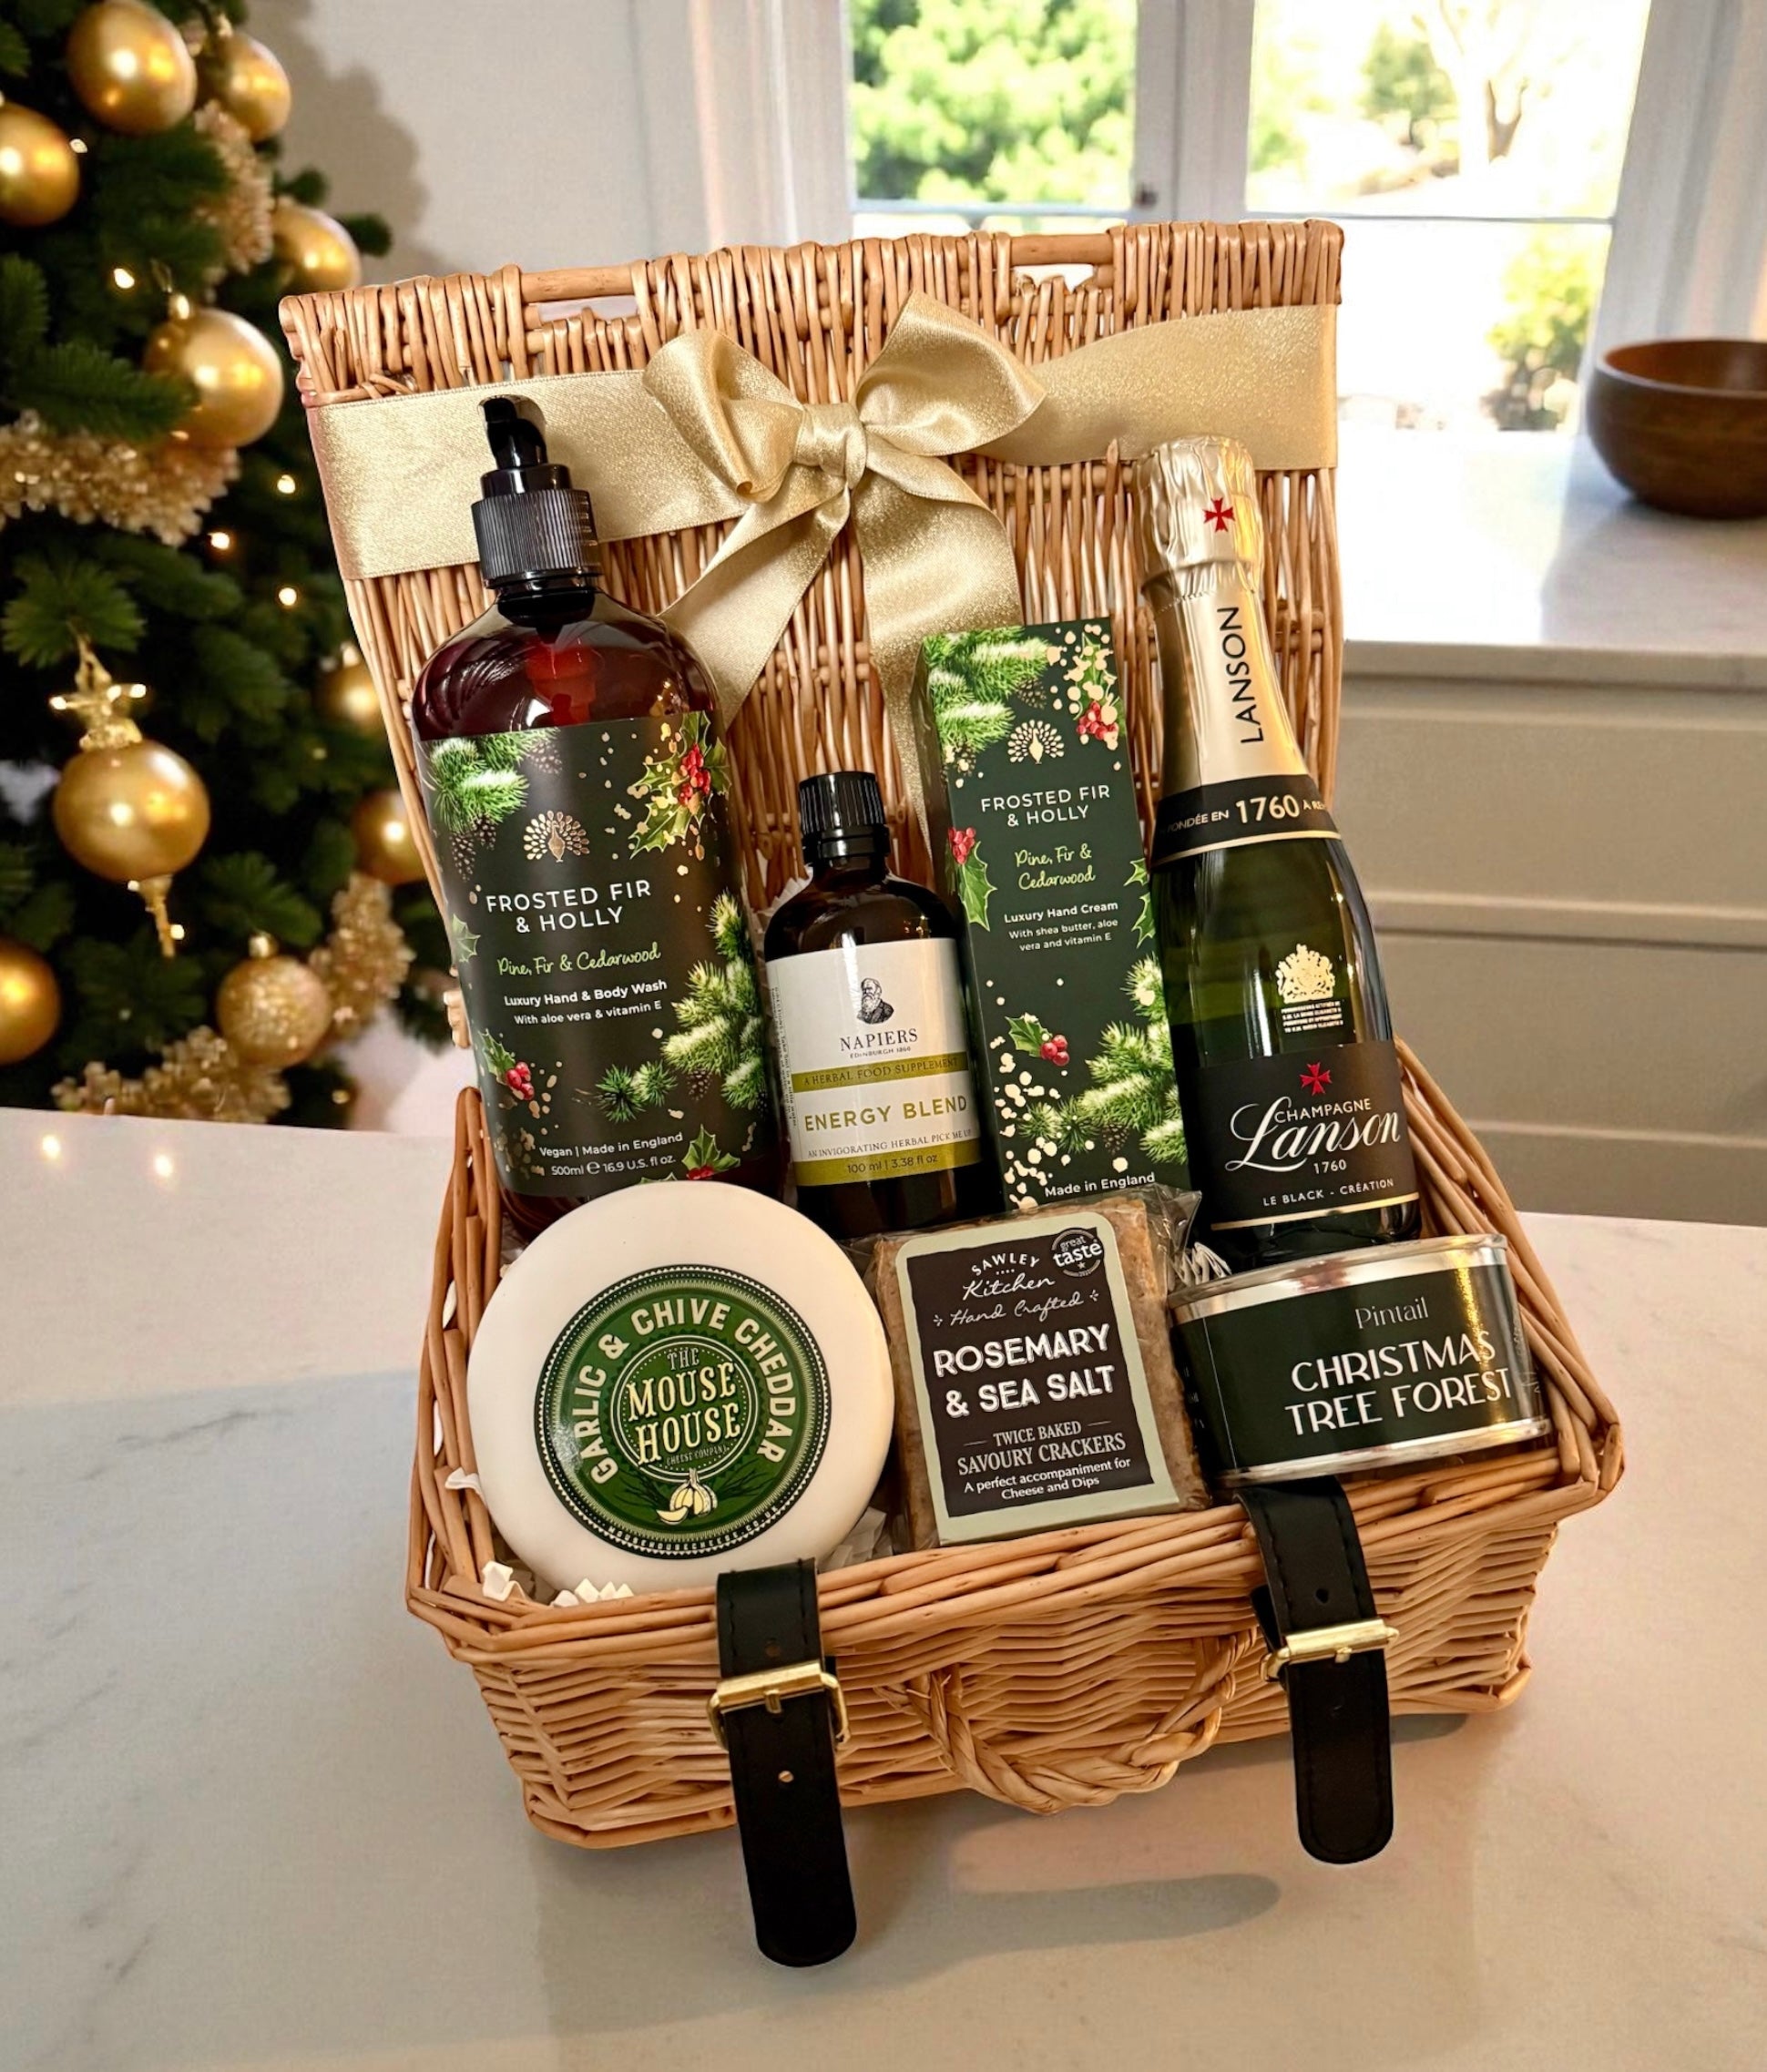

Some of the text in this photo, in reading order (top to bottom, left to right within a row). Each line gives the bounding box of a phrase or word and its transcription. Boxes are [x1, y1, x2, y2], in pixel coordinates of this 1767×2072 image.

[1217, 607, 1264, 743] LANSON
[981, 784, 1109, 812] FROSTED FIR
[1211, 810, 1230, 822] EN
[1236, 794, 1300, 823] 1760
[1007, 804, 1088, 827] & HOLLY
[1015, 843, 1092, 867] Pine, Fir &
[1018, 865, 1096, 890] Cedarwood
[486, 880, 651, 913] FROSTED FIR
[516, 906, 622, 933] & HOLLY
[1004, 902, 1118, 924] Luxury Hand Cream
[1008, 918, 1118, 940] With shea butter, aloe
[1019, 933, 1111, 952] vera and vitamin E
[497, 942, 661, 975] Pine, Fir & Cedarwood
[505, 980, 668, 1007] Luxury Hand & Body Wash
[514, 1001, 662, 1025] With aloe vera & vitamin E
[840, 1028, 918, 1051] NAPIERS
[850, 1048, 894, 1058] EDINBURGH
[812, 1071, 853, 1085] HERBAL
[858, 1067, 891, 1078] FOOD
[895, 1057, 958, 1075] SUPPLEMENT
[805, 1096, 967, 1131] ENERGY BLEND
[1275, 1098, 1372, 1123] CHAMPAGNE
[539, 1147, 573, 1158] Vegan
[582, 1144, 615, 1155] Made
[618, 1142, 629, 1152] in
[633, 1132, 683, 1150] England
[808, 1149, 817, 1158] AN
[820, 1142, 888, 1157] INVIGORATING
[892, 1137, 928, 1148] HERBAL
[932, 1132, 950, 1142] PICK
[953, 1130, 963, 1139] ME
[1225, 1097, 1400, 1172] Lanson
[551, 1165, 584, 1176] 500ml
[603, 1161, 625, 1173] 16.9
[627, 1158, 649, 1169] U.S.
[660, 1155, 676, 1164] oz.
[847, 1163, 865, 1173] 100
[869, 1161, 882, 1171] ml
[892, 1158, 914, 1169] 3.38
[917, 1156, 924, 1164] fl
[927, 1155, 938, 1163] oz
[1313, 1159, 1347, 1174] 1760
[1045, 1172, 1155, 1197] Made in England
[1263, 1196, 1276, 1207] LE
[1282, 1189, 1323, 1204] BLACK
[1340, 1179, 1394, 1194] CRÉATION
[1053, 1243, 1102, 1267] taste
[1060, 1236, 1086, 1252] great
[971, 1253, 1040, 1276] SAWLEY
[962, 1273, 1056, 1301] Kitchen
[950, 1292, 1084, 1327] Hand Crafted
[1354, 1297, 1429, 1330] Pintail
[668, 1347, 700, 1370] THE
[933, 1323, 1109, 1377] ROSEMARY
[1291, 1332, 1496, 1393] CHRISTMAS
[572, 1298, 796, 1485] GARLIC & CHIVE CHEDDAR
[627, 1362, 736, 1422] MOUSE
[945, 1365, 1115, 1418] & SEA SALT
[1284, 1368, 1512, 1435] TREE FOREST
[635, 1403, 741, 1465] HOUSE
[993, 1420, 1082, 1447] TWICE BAKED
[957, 1433, 1126, 1475] SAVOURY CRACKERS
[964, 1458, 1130, 1494] A perfect accompaniment for
[1002, 1477, 1099, 1499] Cheese and Dips
